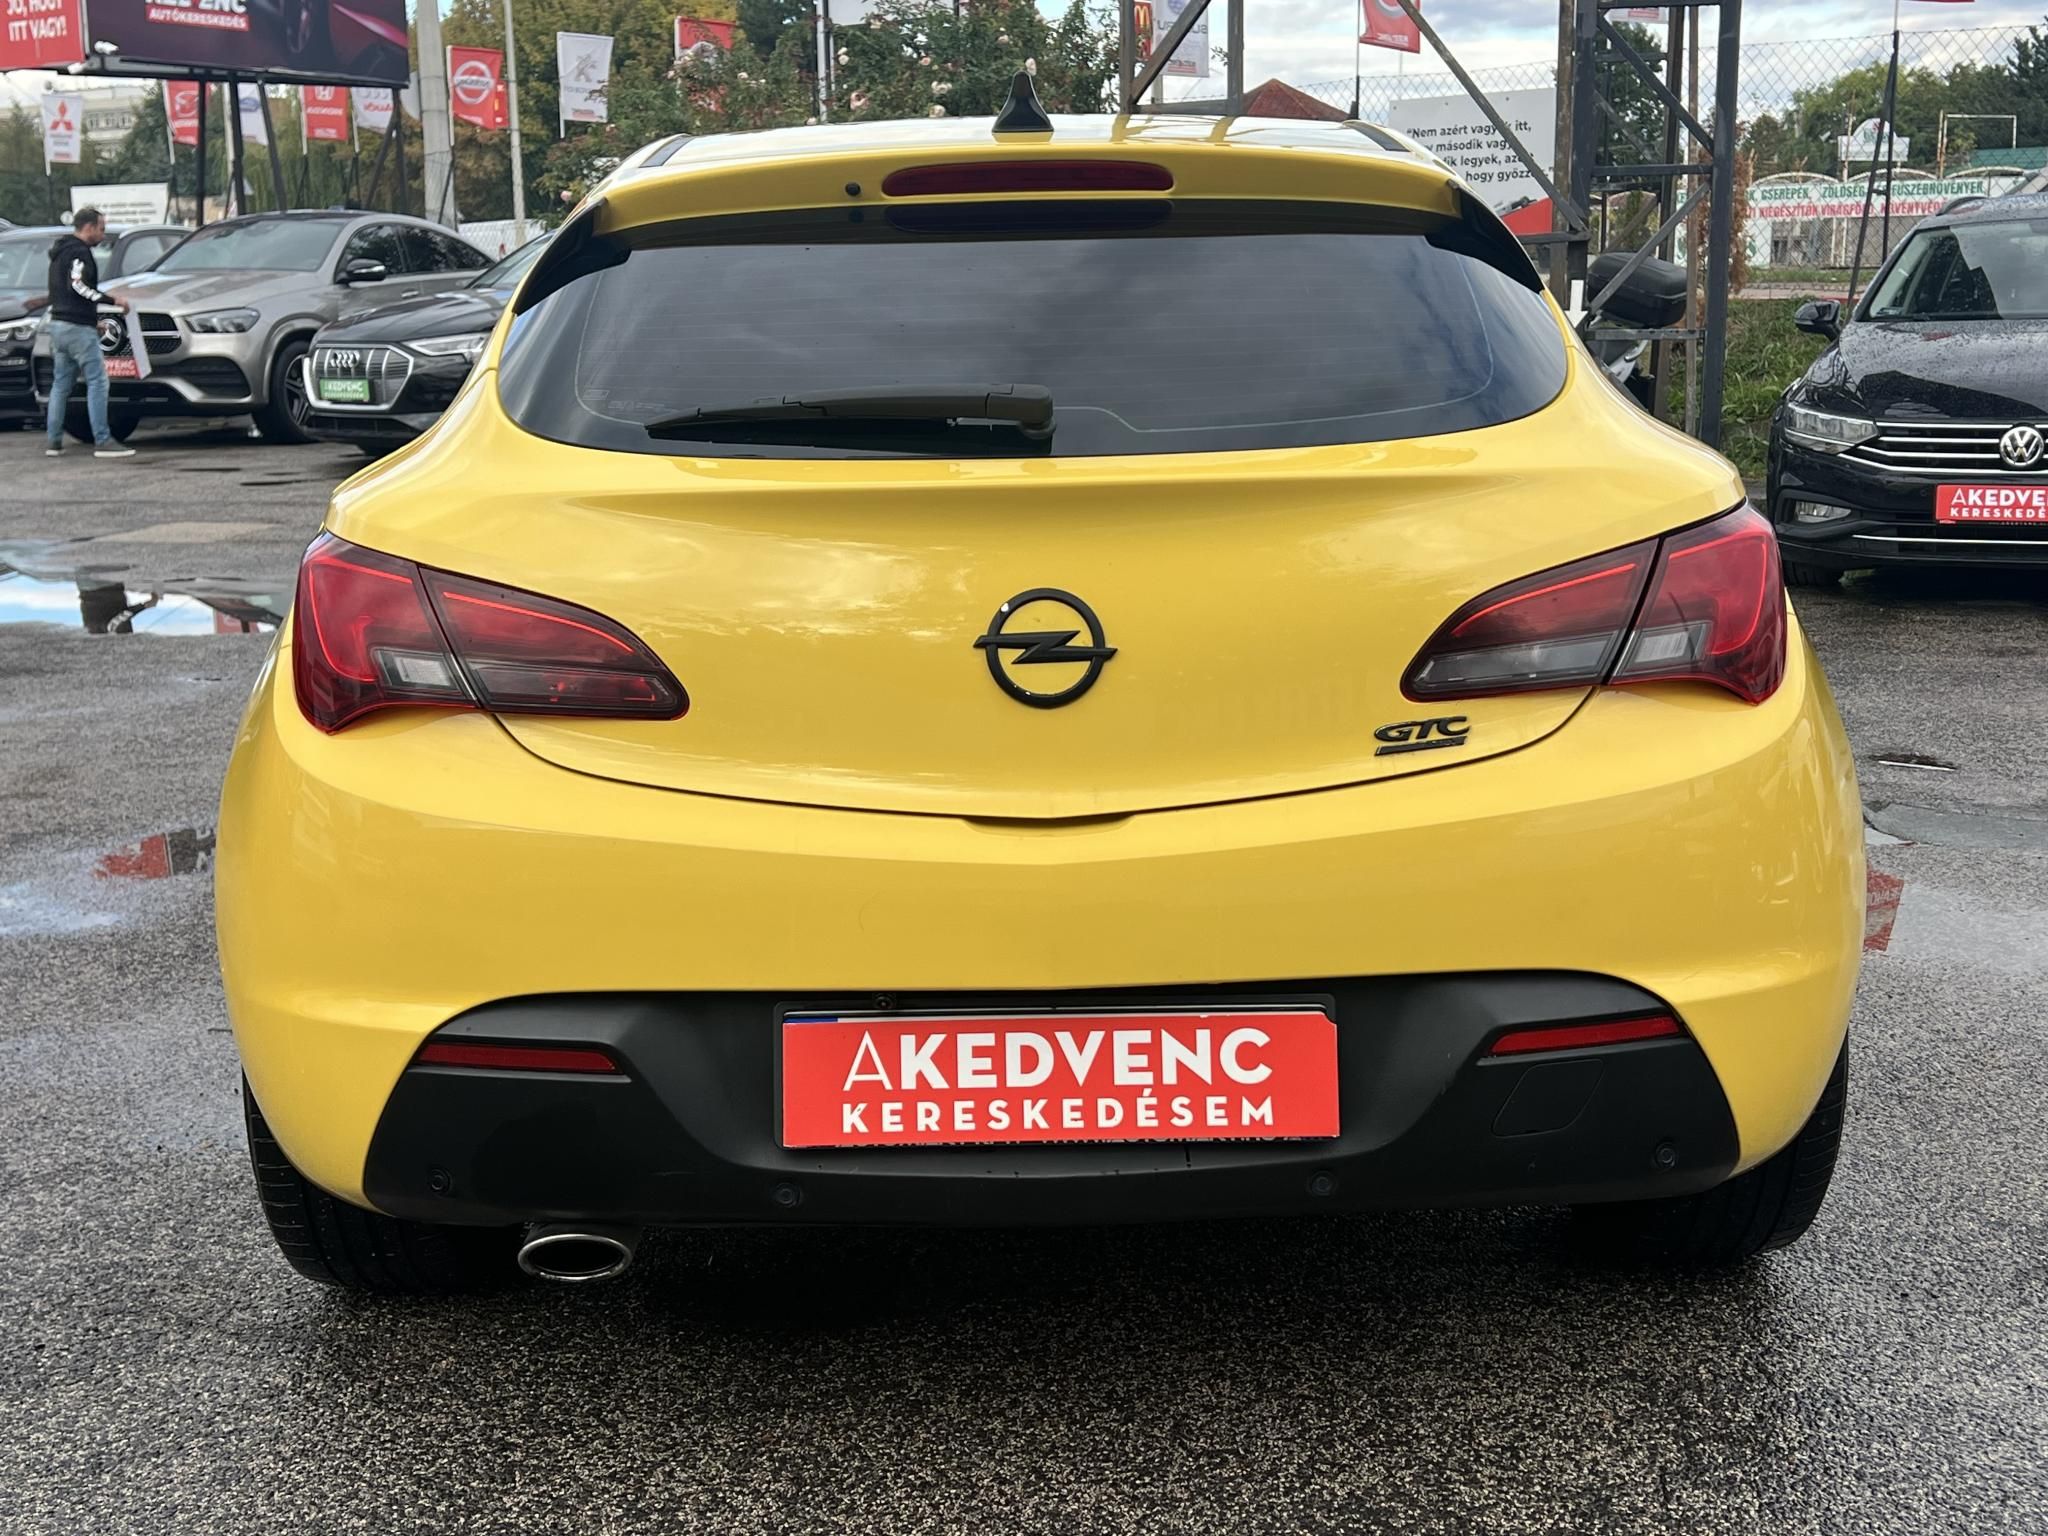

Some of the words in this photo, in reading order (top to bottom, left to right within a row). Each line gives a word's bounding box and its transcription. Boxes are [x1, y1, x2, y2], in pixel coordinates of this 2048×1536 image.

[8, 19, 28, 42] ITT
[29, 15, 67, 40] VAGY!
[1440, 124, 1468, 136] azért
[1515, 120, 1531, 132] itt,
[1436, 139, 1483, 152] második
[1460, 153, 1501, 168] legyek,
[1465, 171, 1494, 181] hogy
[1951, 488, 2048, 507] AKEDVE
[1950, 506, 2046, 518] KERESKEDÉ
[1374, 716, 1471, 742] GTC
[842, 1027, 1273, 1091] AKEDVENC
[842, 1088, 1274, 1134] KERESKEDÉSEM
